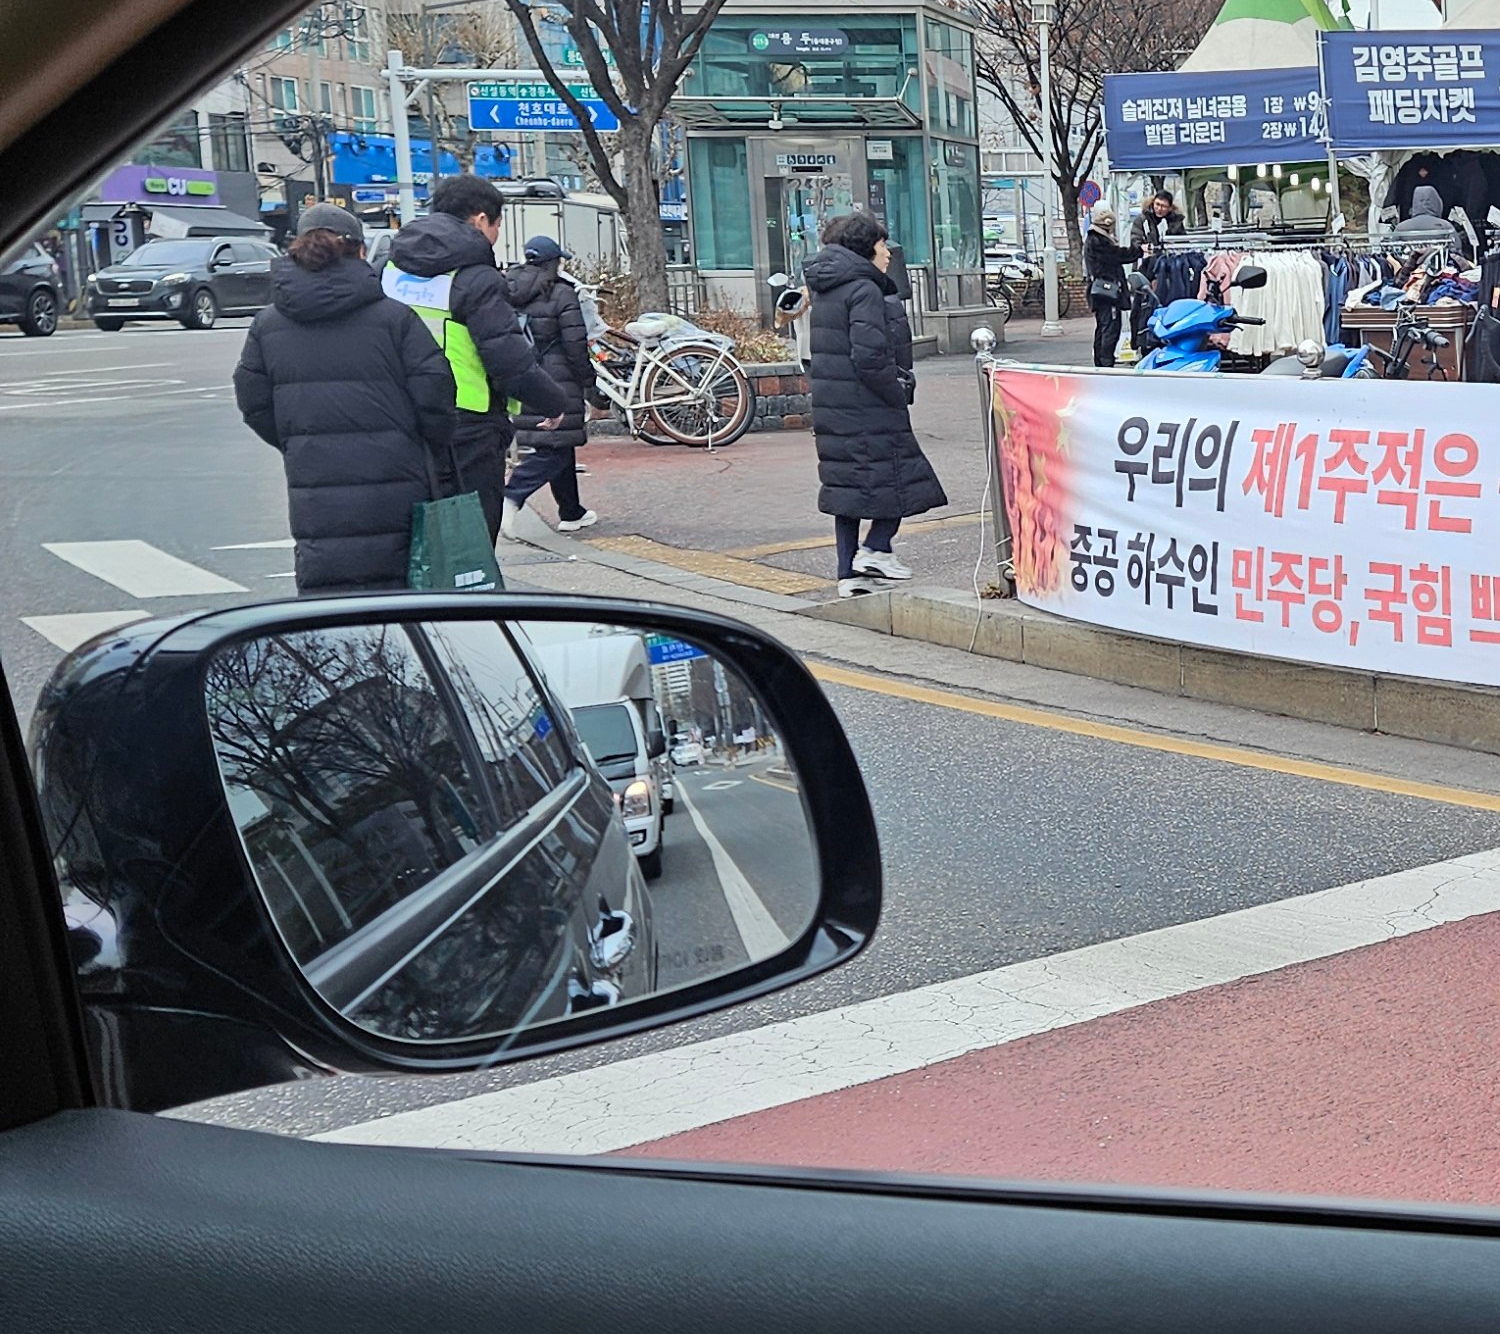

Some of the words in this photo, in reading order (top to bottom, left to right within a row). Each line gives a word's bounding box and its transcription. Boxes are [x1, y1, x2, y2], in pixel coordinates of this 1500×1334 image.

[1352, 45, 1485, 83] 김영주골프
[518, 103, 569, 116] 천호대로
[1186, 96, 1247, 120] 남녀공용
[1263, 96, 1283, 114] 1장
[1293, 91, 1319, 111] ₩9
[1367, 87, 1476, 125] 패딩자켓
[1145, 123, 1177, 146] 발열
[1179, 121, 1225, 144] 라운티
[1283, 117, 1320, 137] ₩14
[168, 178, 187, 195] CU
[115, 221, 128, 247] CU
[1114, 416, 1240, 512] 우리의
[1242, 423, 1482, 534] 제1주적은
[1068, 524, 1119, 597] 중공
[1127, 532, 1219, 616] 하수인
